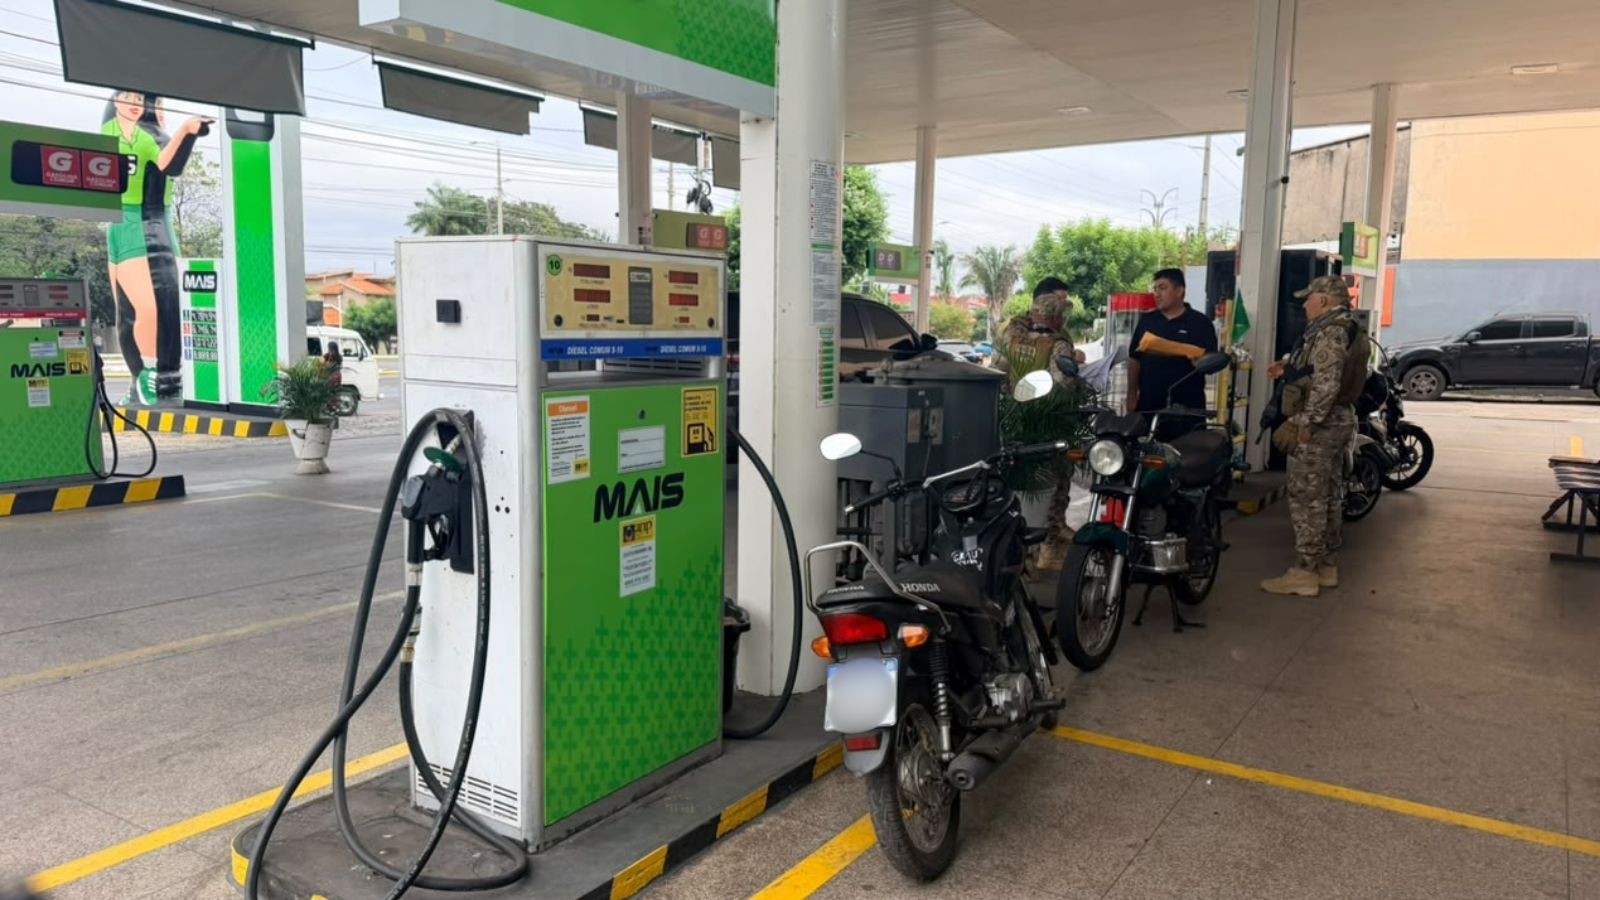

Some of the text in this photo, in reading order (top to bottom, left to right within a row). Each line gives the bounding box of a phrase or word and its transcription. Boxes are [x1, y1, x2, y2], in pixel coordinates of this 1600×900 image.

[48, 151, 74, 172] G
[88, 156, 112, 176] G
[549, 260, 561, 271] 10
[184, 274, 216, 290] MAIS
[567, 345, 588, 355] DIESEL
[10, 362, 67, 378] MAIS
[593, 472, 685, 523] MAIS
[900, 583, 942, 593] HONDA
